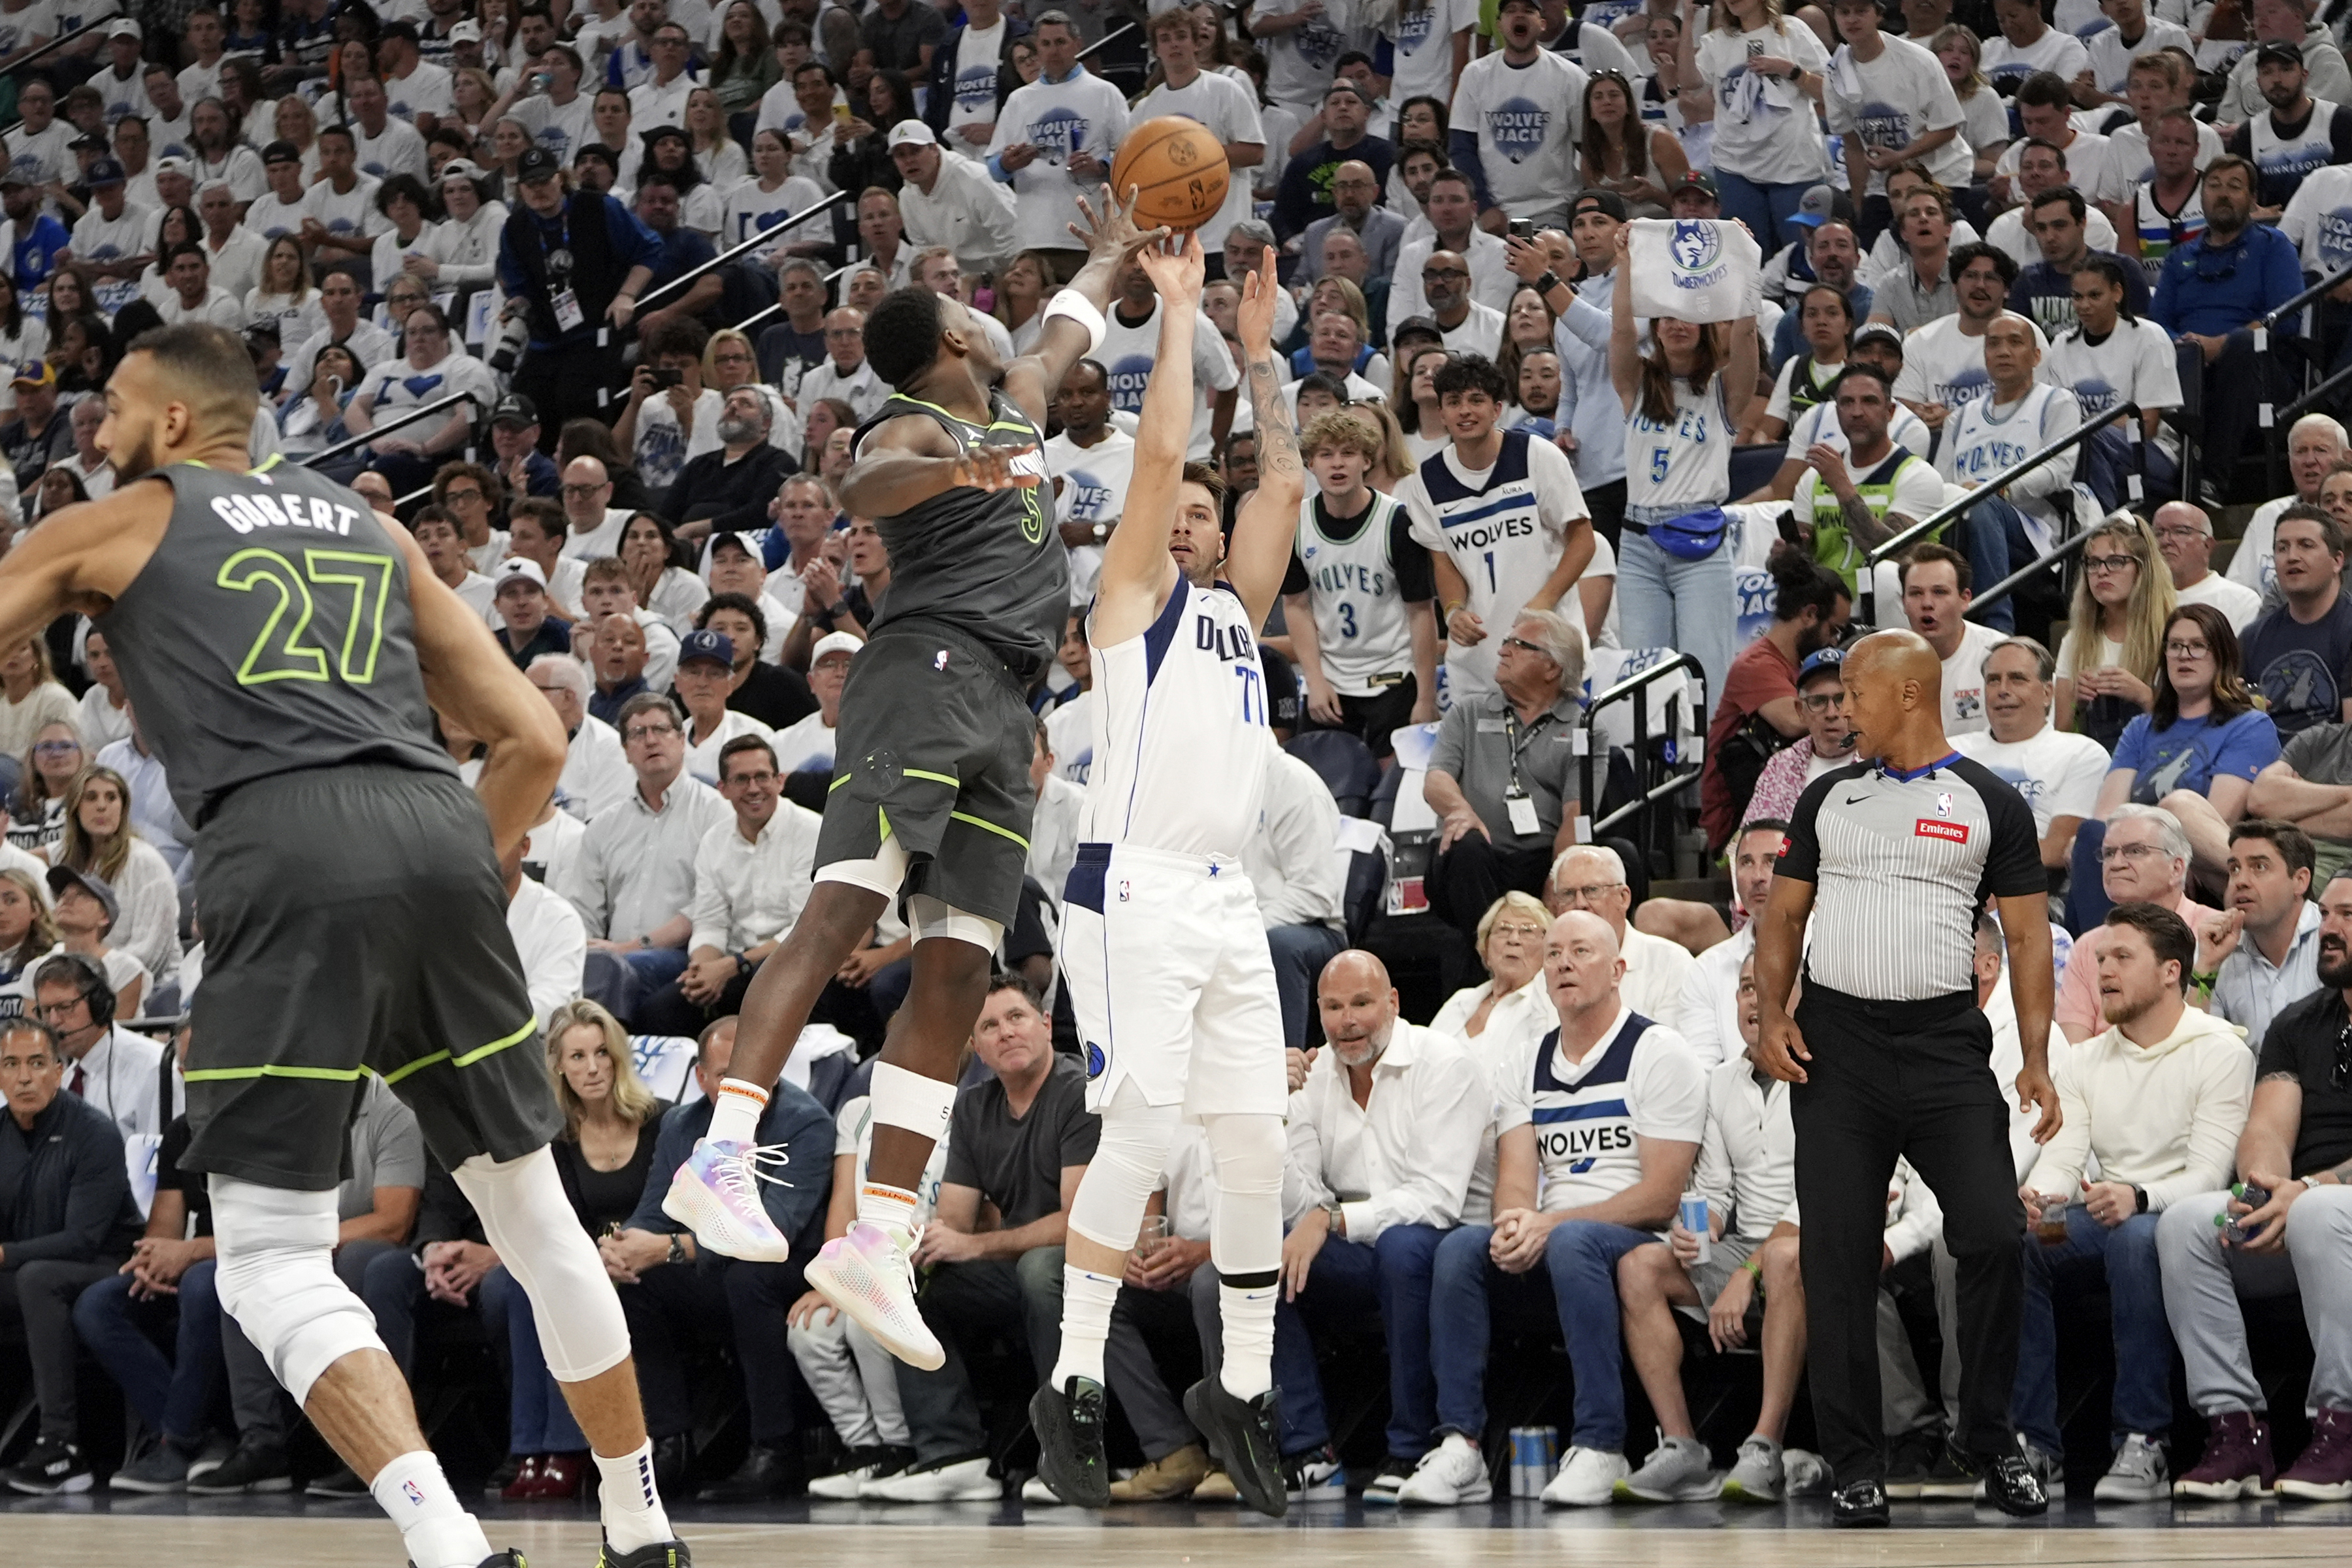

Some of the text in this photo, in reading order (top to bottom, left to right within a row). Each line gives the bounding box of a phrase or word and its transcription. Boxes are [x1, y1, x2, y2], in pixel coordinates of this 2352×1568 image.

[1026, 120, 1089, 135] WOLVES
[1485, 111, 1551, 128] WOLVES
[1495, 128, 1542, 141] BACK
[374, 376, 401, 406] I
[1650, 446, 1671, 485] 5
[210, 492, 359, 537] GOBERT
[1021, 483, 1043, 544] 5
[1450, 517, 1533, 552] WOLVES
[1483, 551, 1497, 593] 1
[217, 547, 393, 685] 27
[1337, 602, 1358, 638] 3
[1235, 664, 1264, 728] 77
[1920, 823, 1963, 838] Emirates
[940, 1106, 950, 1120] 5
[1538, 1125, 1631, 1156] WOLVES
